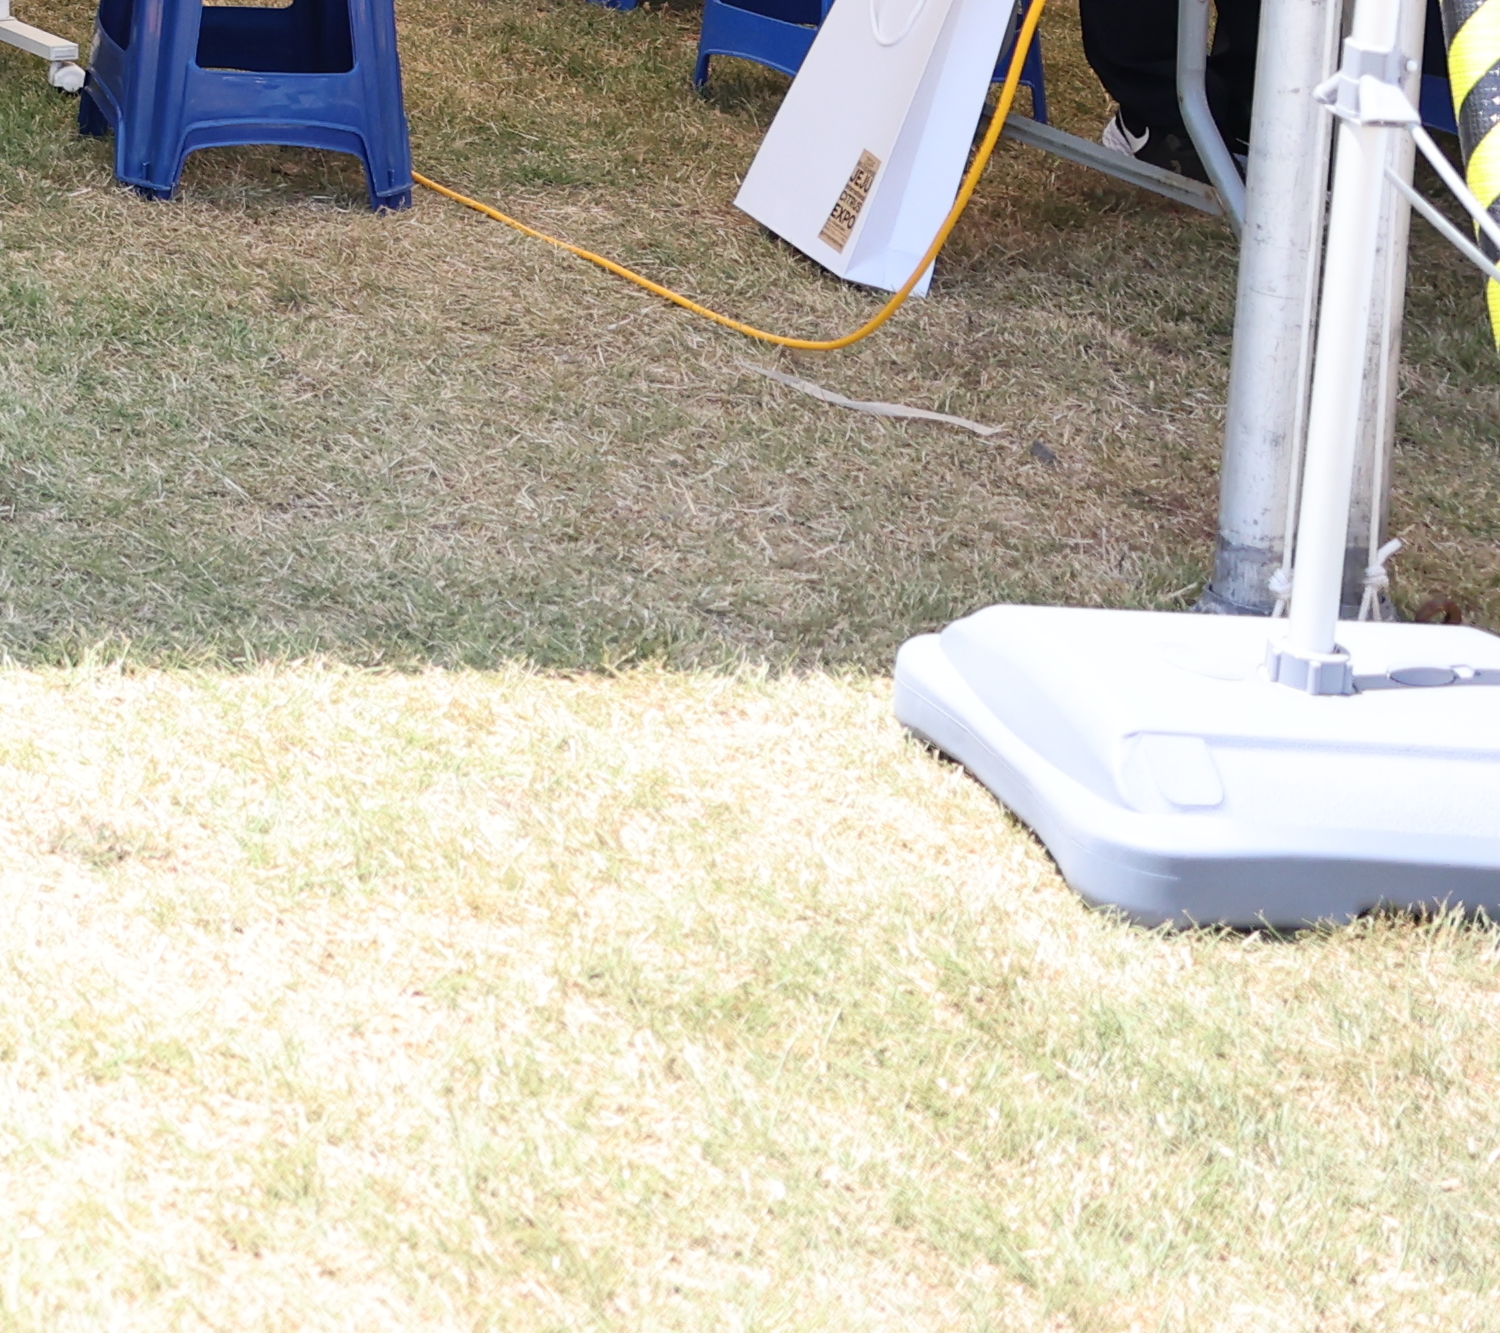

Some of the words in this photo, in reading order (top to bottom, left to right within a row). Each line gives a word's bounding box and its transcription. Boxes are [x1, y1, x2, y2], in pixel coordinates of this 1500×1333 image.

[849, 168, 874, 193] JEJU
[839, 190, 863, 214] CITRUS
[830, 202, 856, 230] EXPO
